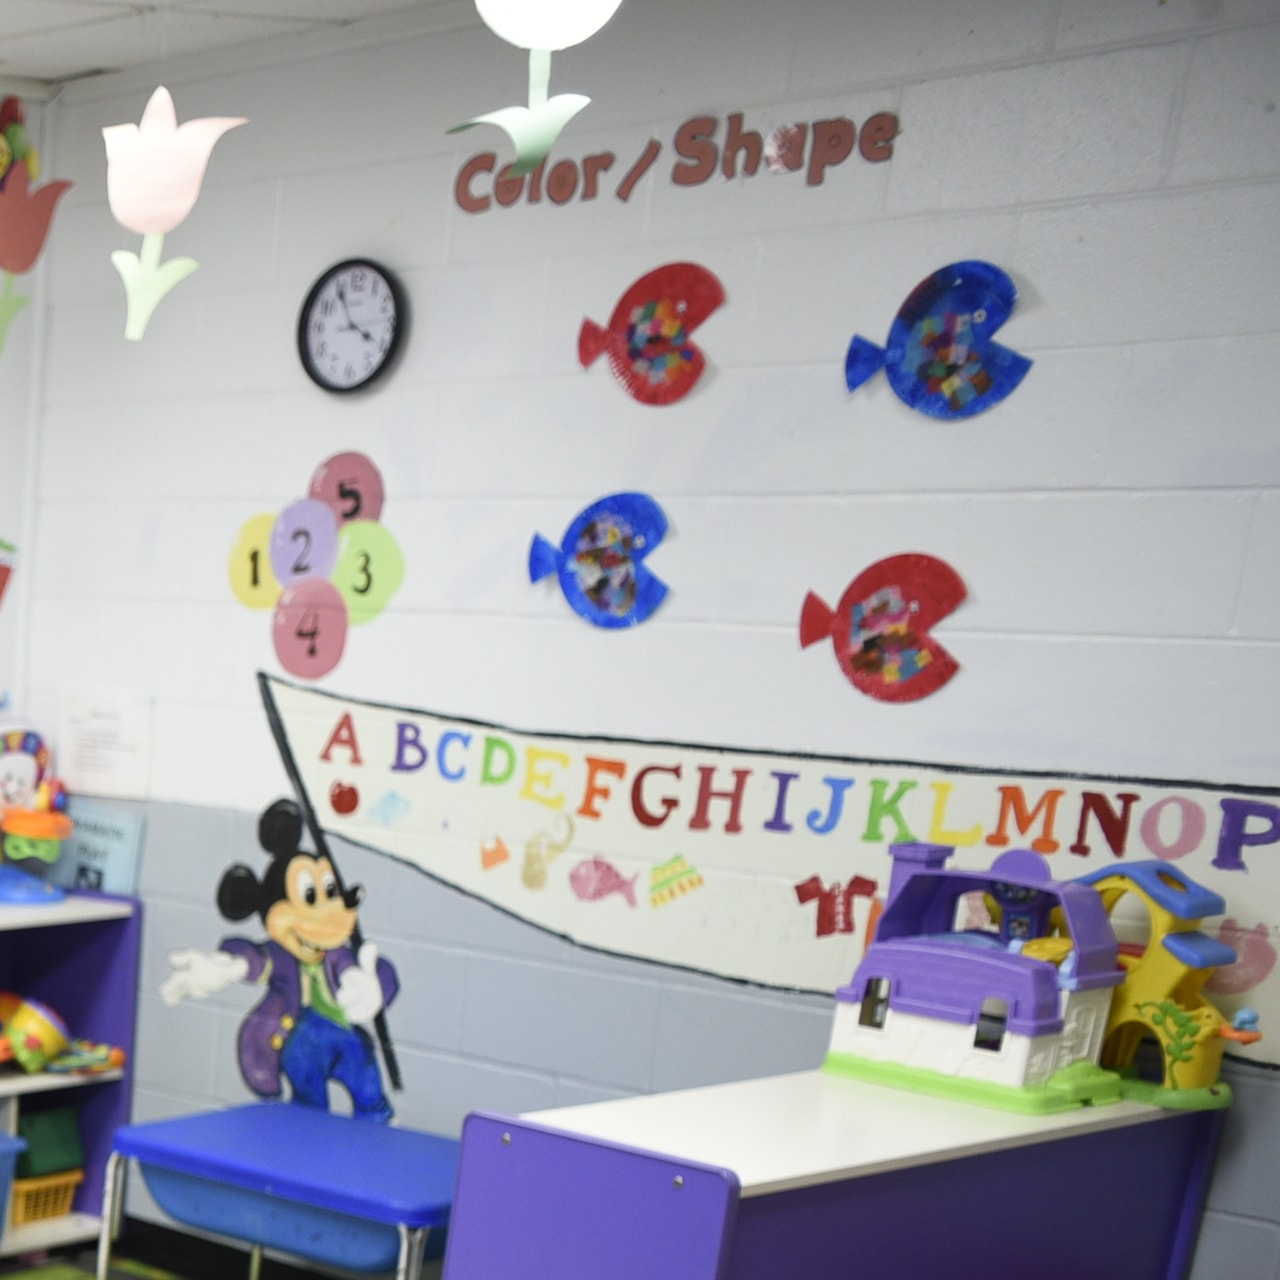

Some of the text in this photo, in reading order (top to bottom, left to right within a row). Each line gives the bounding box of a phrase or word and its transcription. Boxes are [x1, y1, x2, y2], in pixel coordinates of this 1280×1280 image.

[338, 478, 362, 519] 5
[249, 528, 373, 594] 1 2 3
[296, 608, 321, 657] 4
